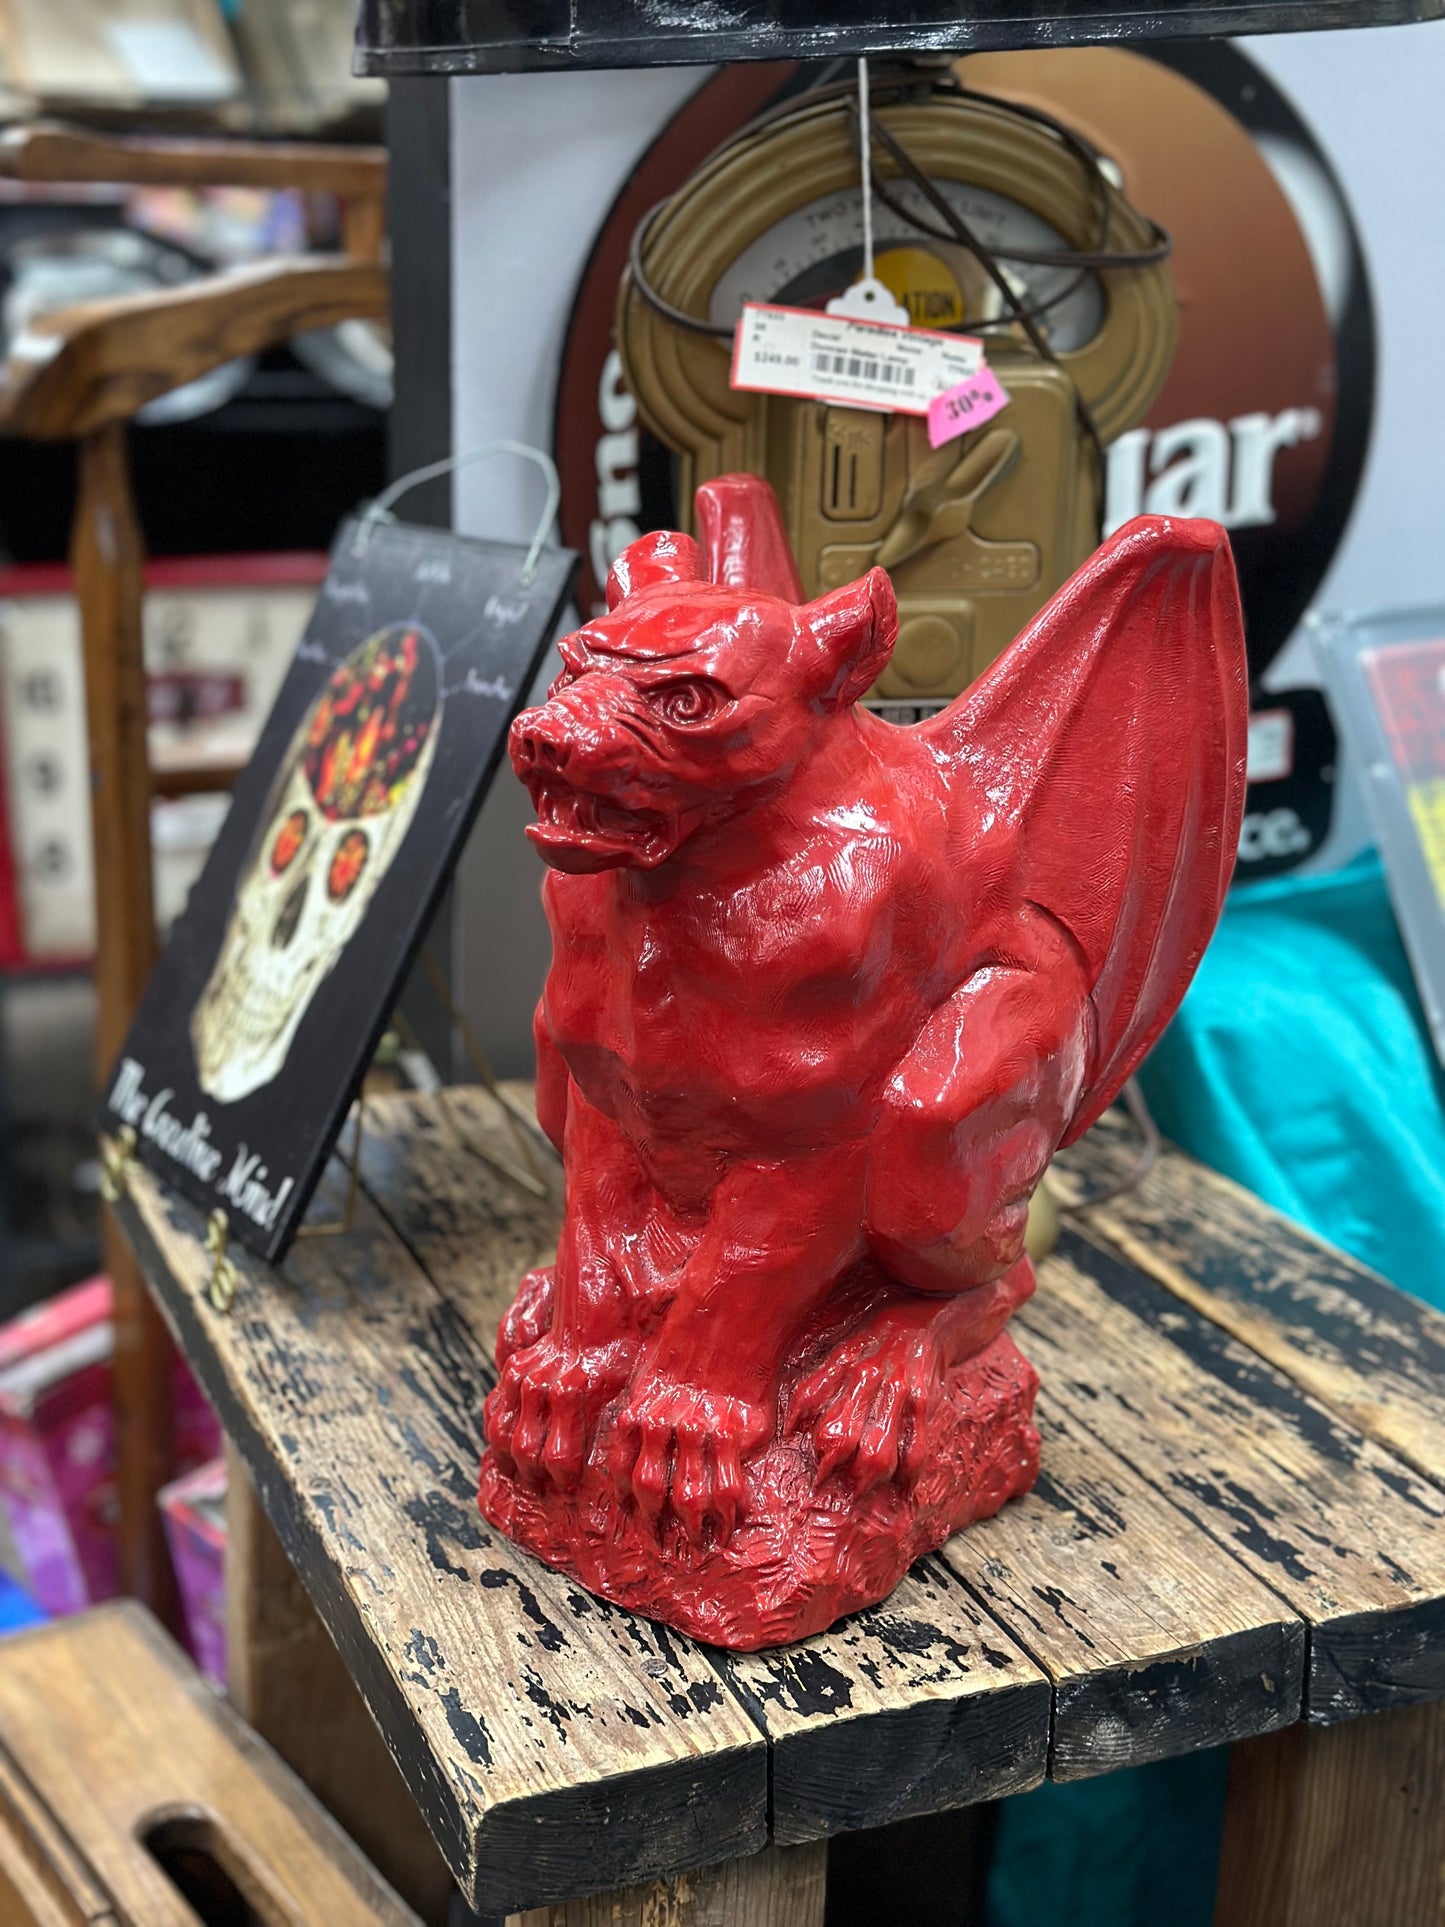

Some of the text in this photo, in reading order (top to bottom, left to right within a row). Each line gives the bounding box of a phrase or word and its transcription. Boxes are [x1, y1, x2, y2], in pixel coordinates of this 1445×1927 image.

[945, 388, 994, 421] 30%
[108, 1057, 150, 1125] The
[141, 1087, 223, 1182] Creative
